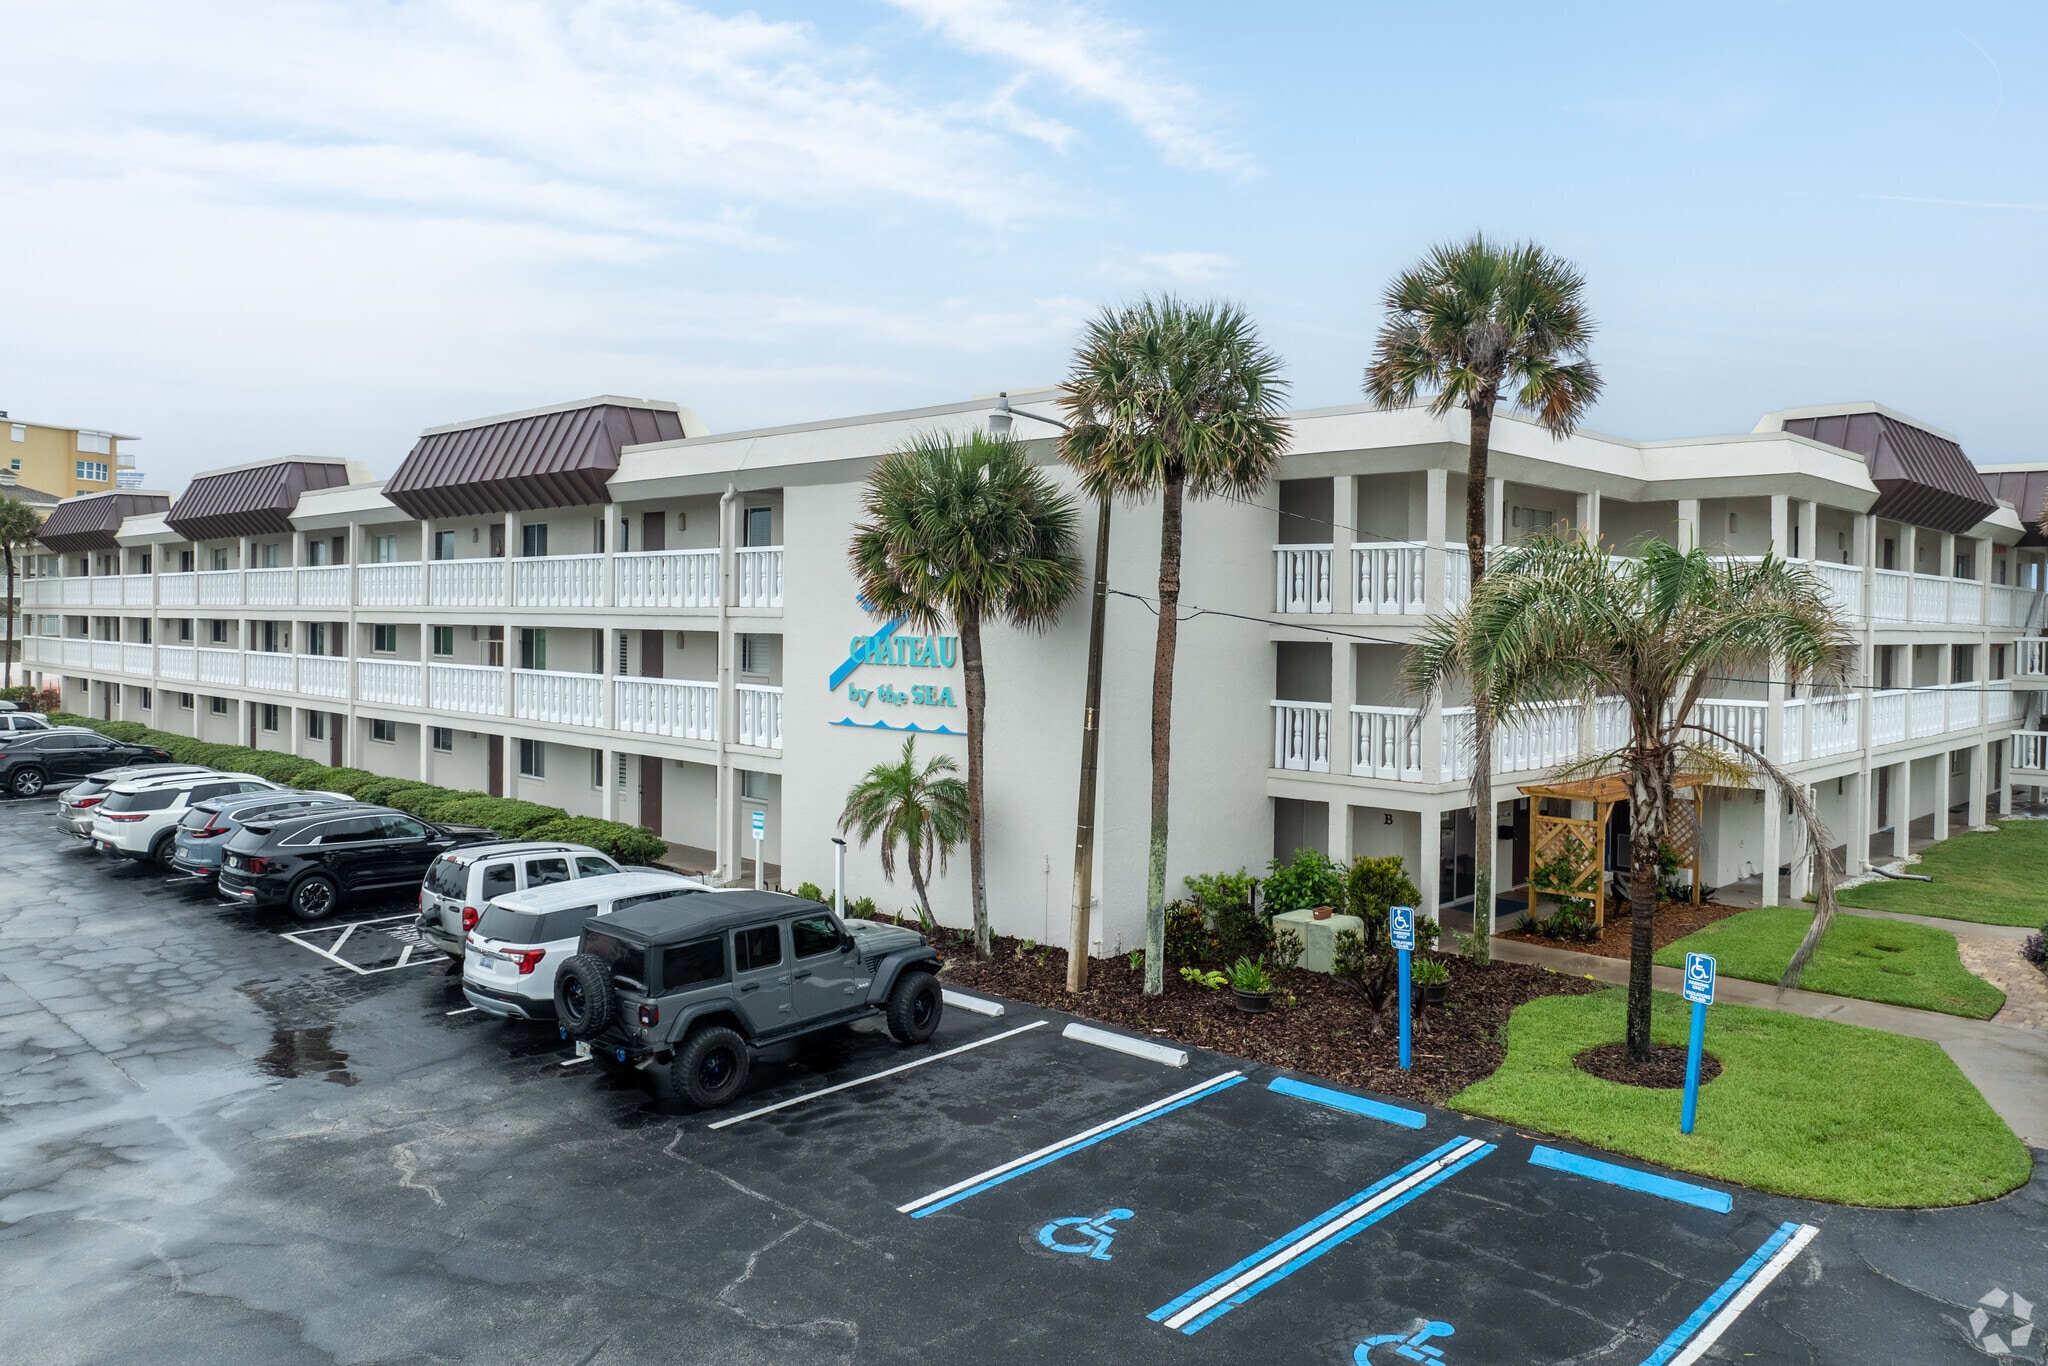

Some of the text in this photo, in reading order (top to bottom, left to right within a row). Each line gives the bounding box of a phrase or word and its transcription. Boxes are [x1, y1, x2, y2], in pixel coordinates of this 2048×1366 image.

[850, 635, 958, 668] CHATEAU
[848, 682, 957, 708] by the SEA
[1384, 813, 1393, 825] B
